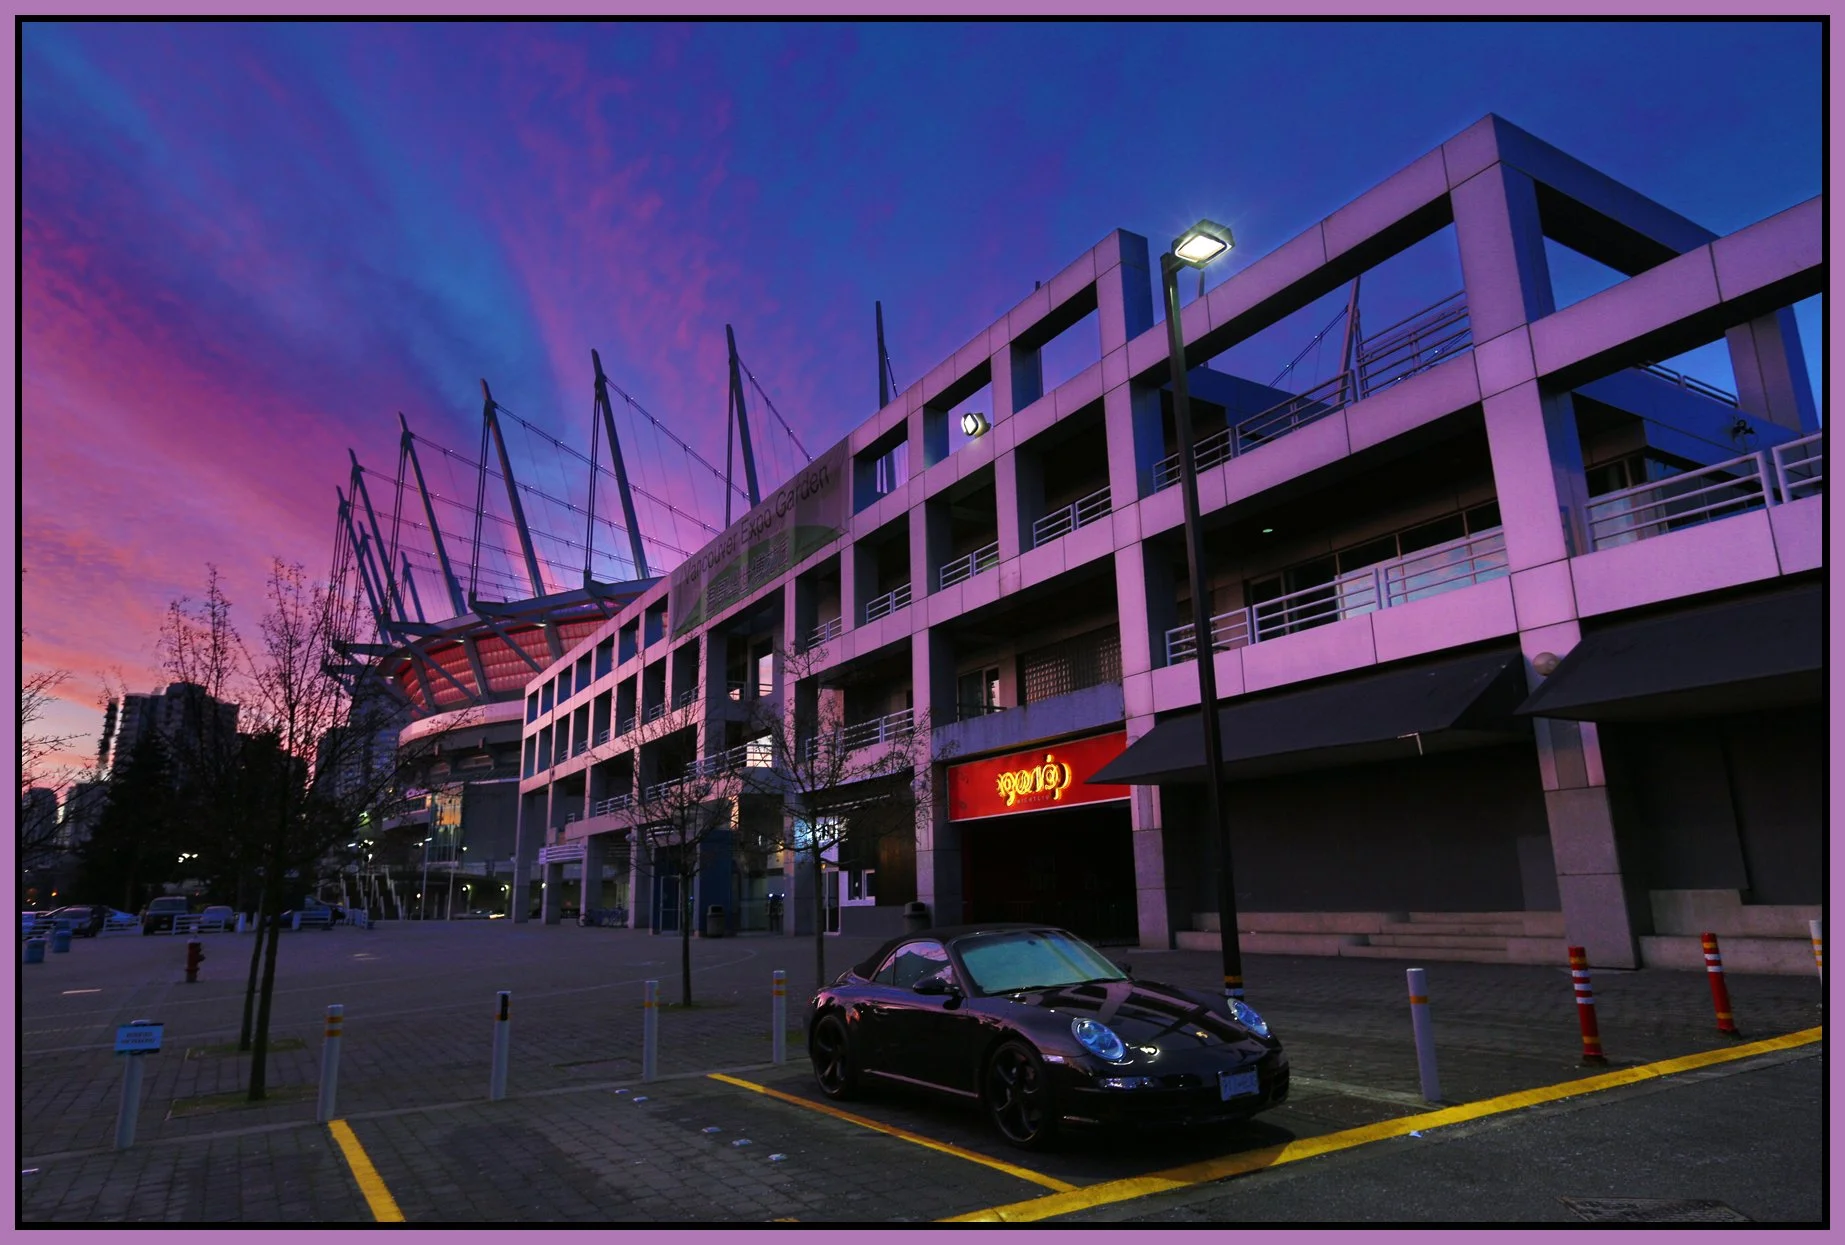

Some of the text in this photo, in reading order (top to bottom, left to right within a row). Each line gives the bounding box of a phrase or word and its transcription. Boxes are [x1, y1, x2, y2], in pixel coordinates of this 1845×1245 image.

[683, 532, 737, 584] Vancouver
[741, 508, 772, 545] Expo
[775, 465, 830, 518] Garden
